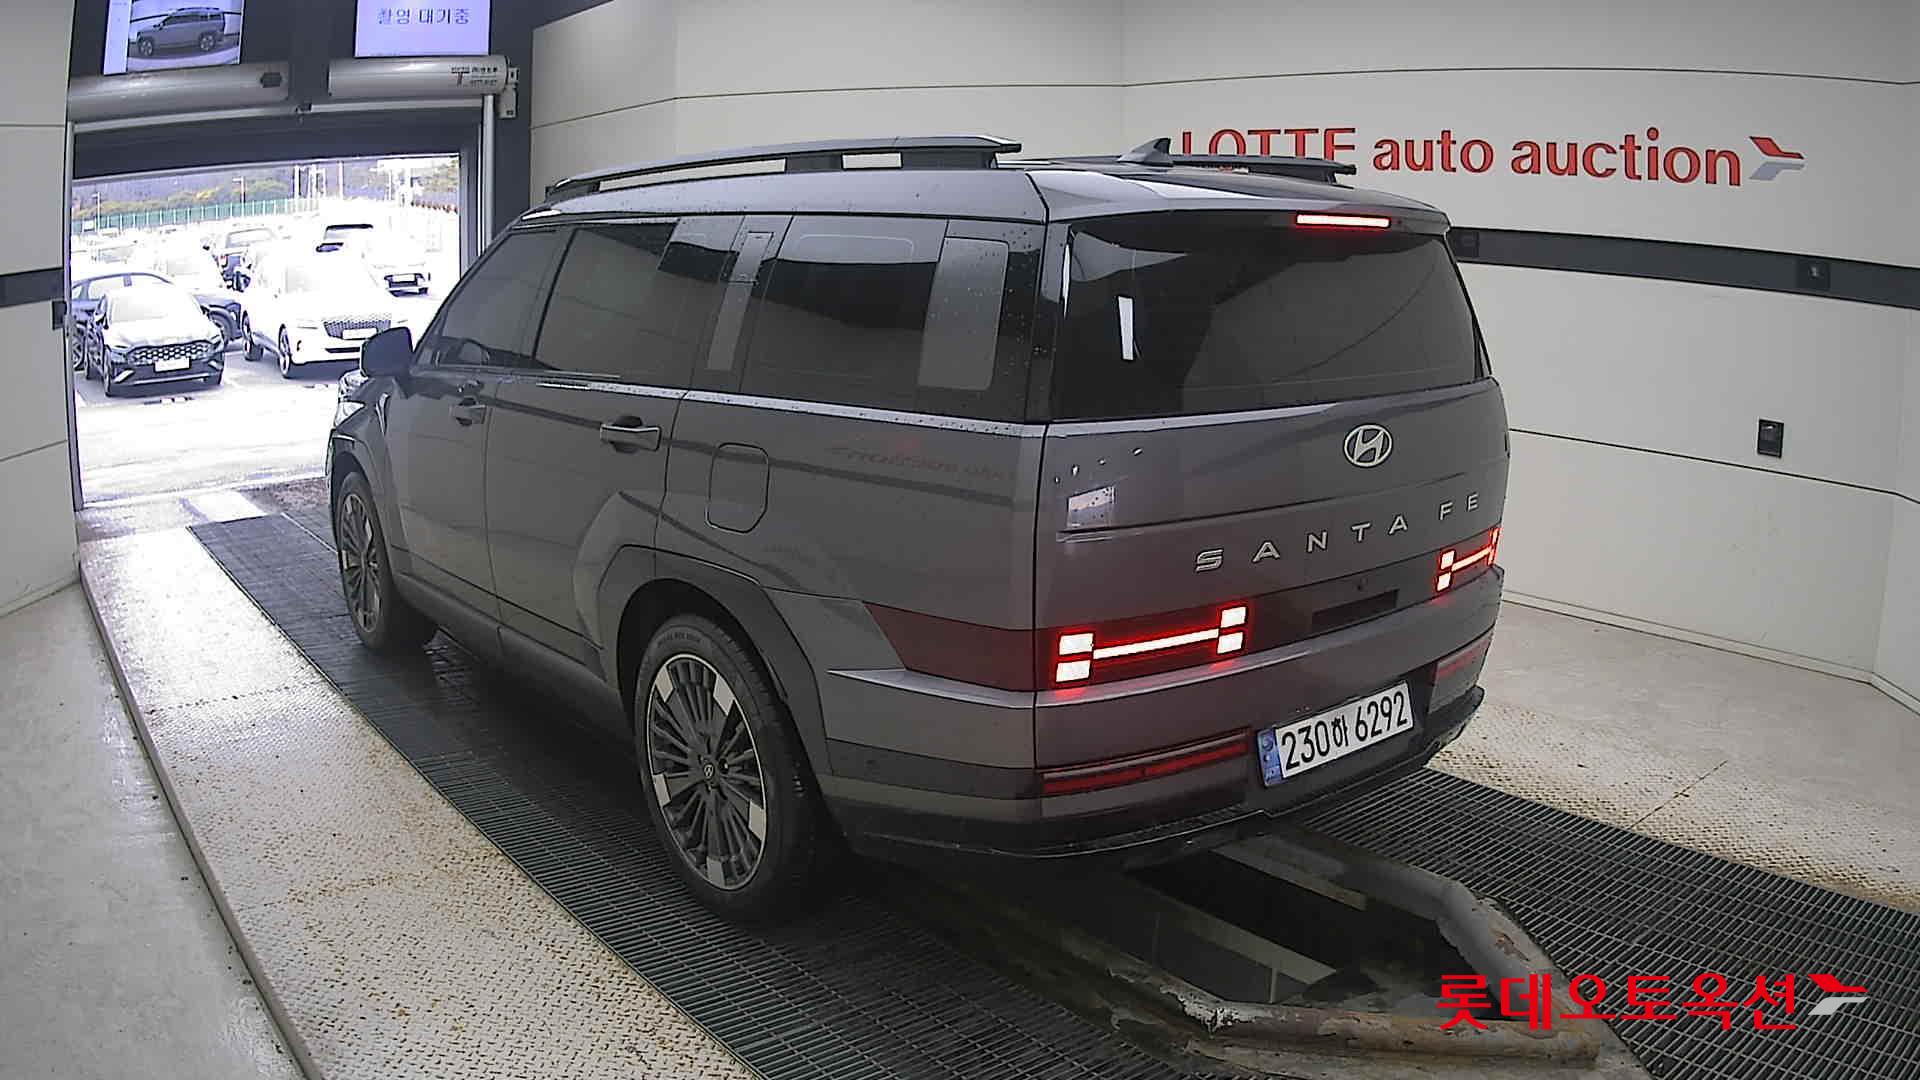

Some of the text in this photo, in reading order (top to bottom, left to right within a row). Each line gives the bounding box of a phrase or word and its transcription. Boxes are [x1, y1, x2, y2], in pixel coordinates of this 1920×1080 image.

[419, 8, 469, 24] 대기중
[1373, 129, 1494, 173] auto
[1511, 127, 1741, 186] auction
[1195, 493, 1480, 572] SANTA FE
[1281, 690, 1408, 772] 230하 6292
